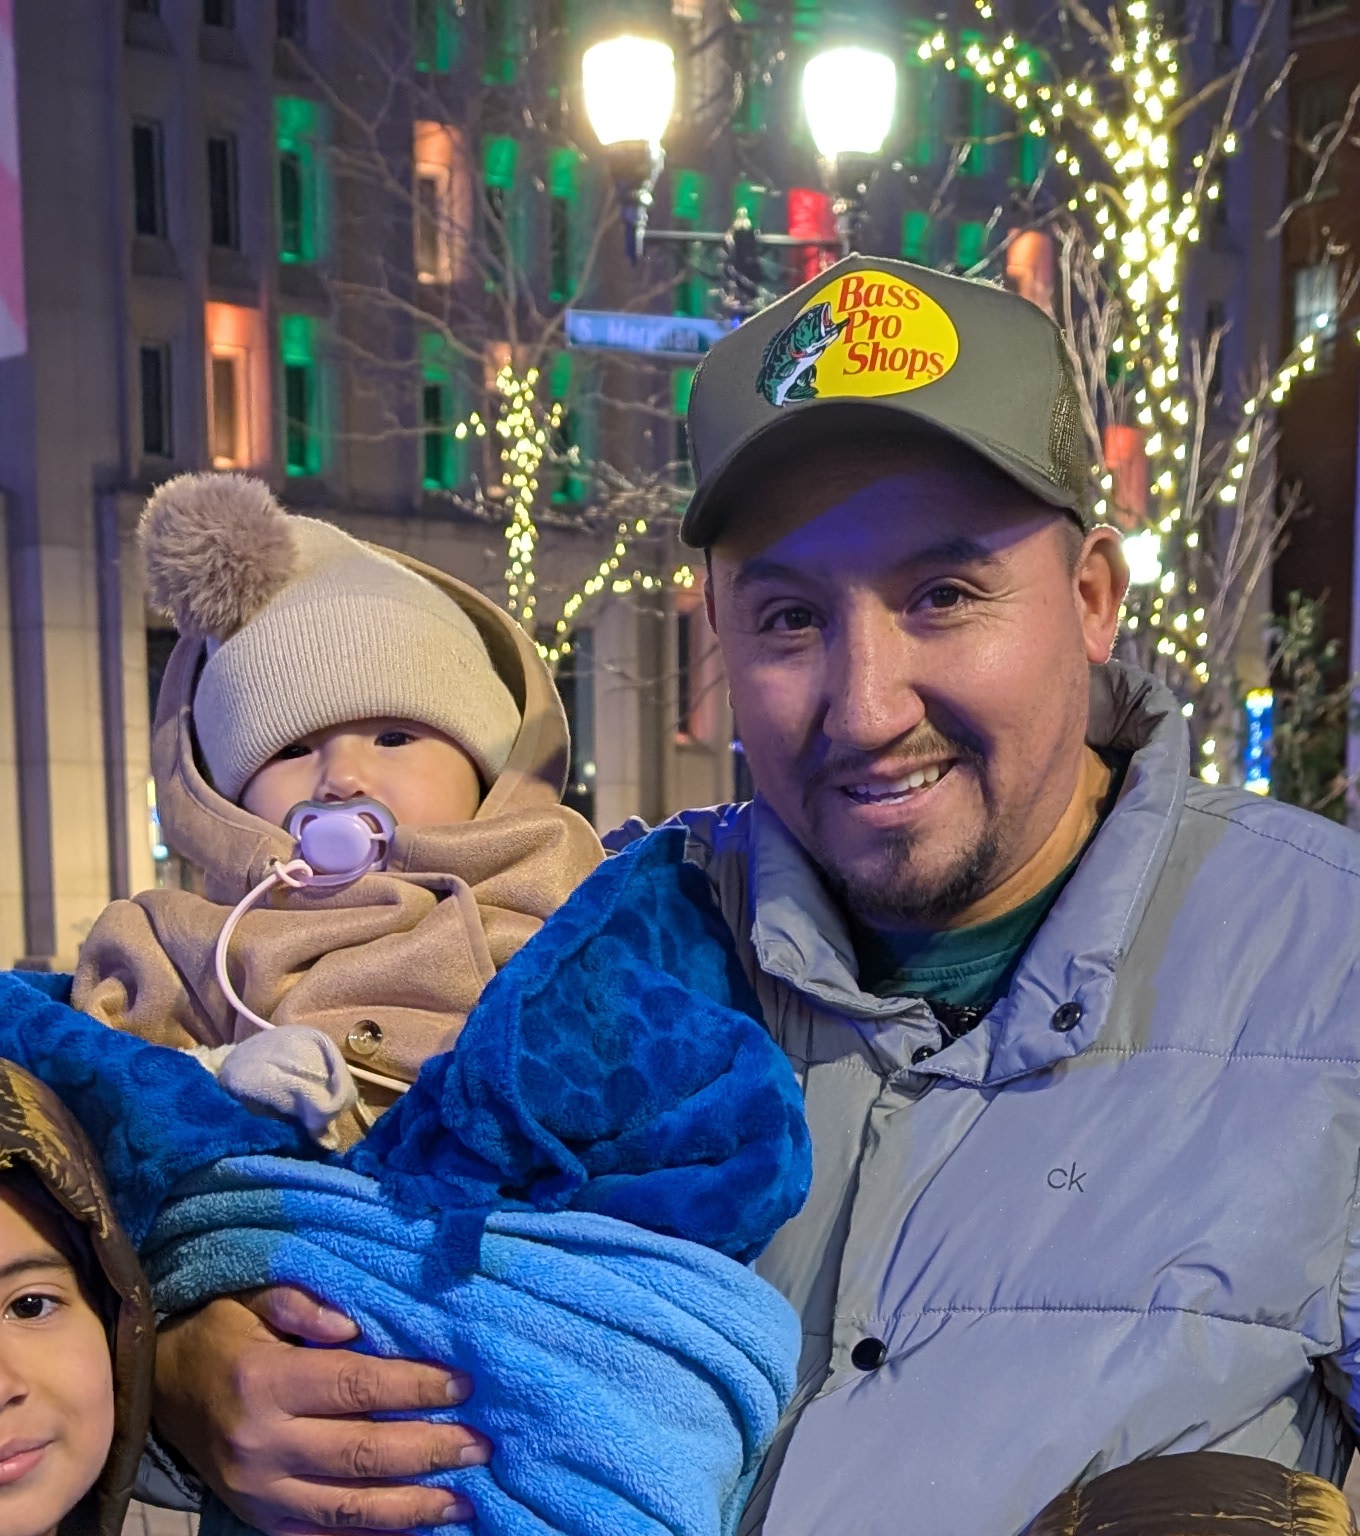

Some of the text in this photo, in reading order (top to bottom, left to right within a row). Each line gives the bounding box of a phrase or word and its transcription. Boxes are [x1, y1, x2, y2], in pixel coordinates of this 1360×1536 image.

[836, 275, 921, 313] Bass
[842, 309, 902, 344] Pro
[842, 341, 945, 381] Shops
